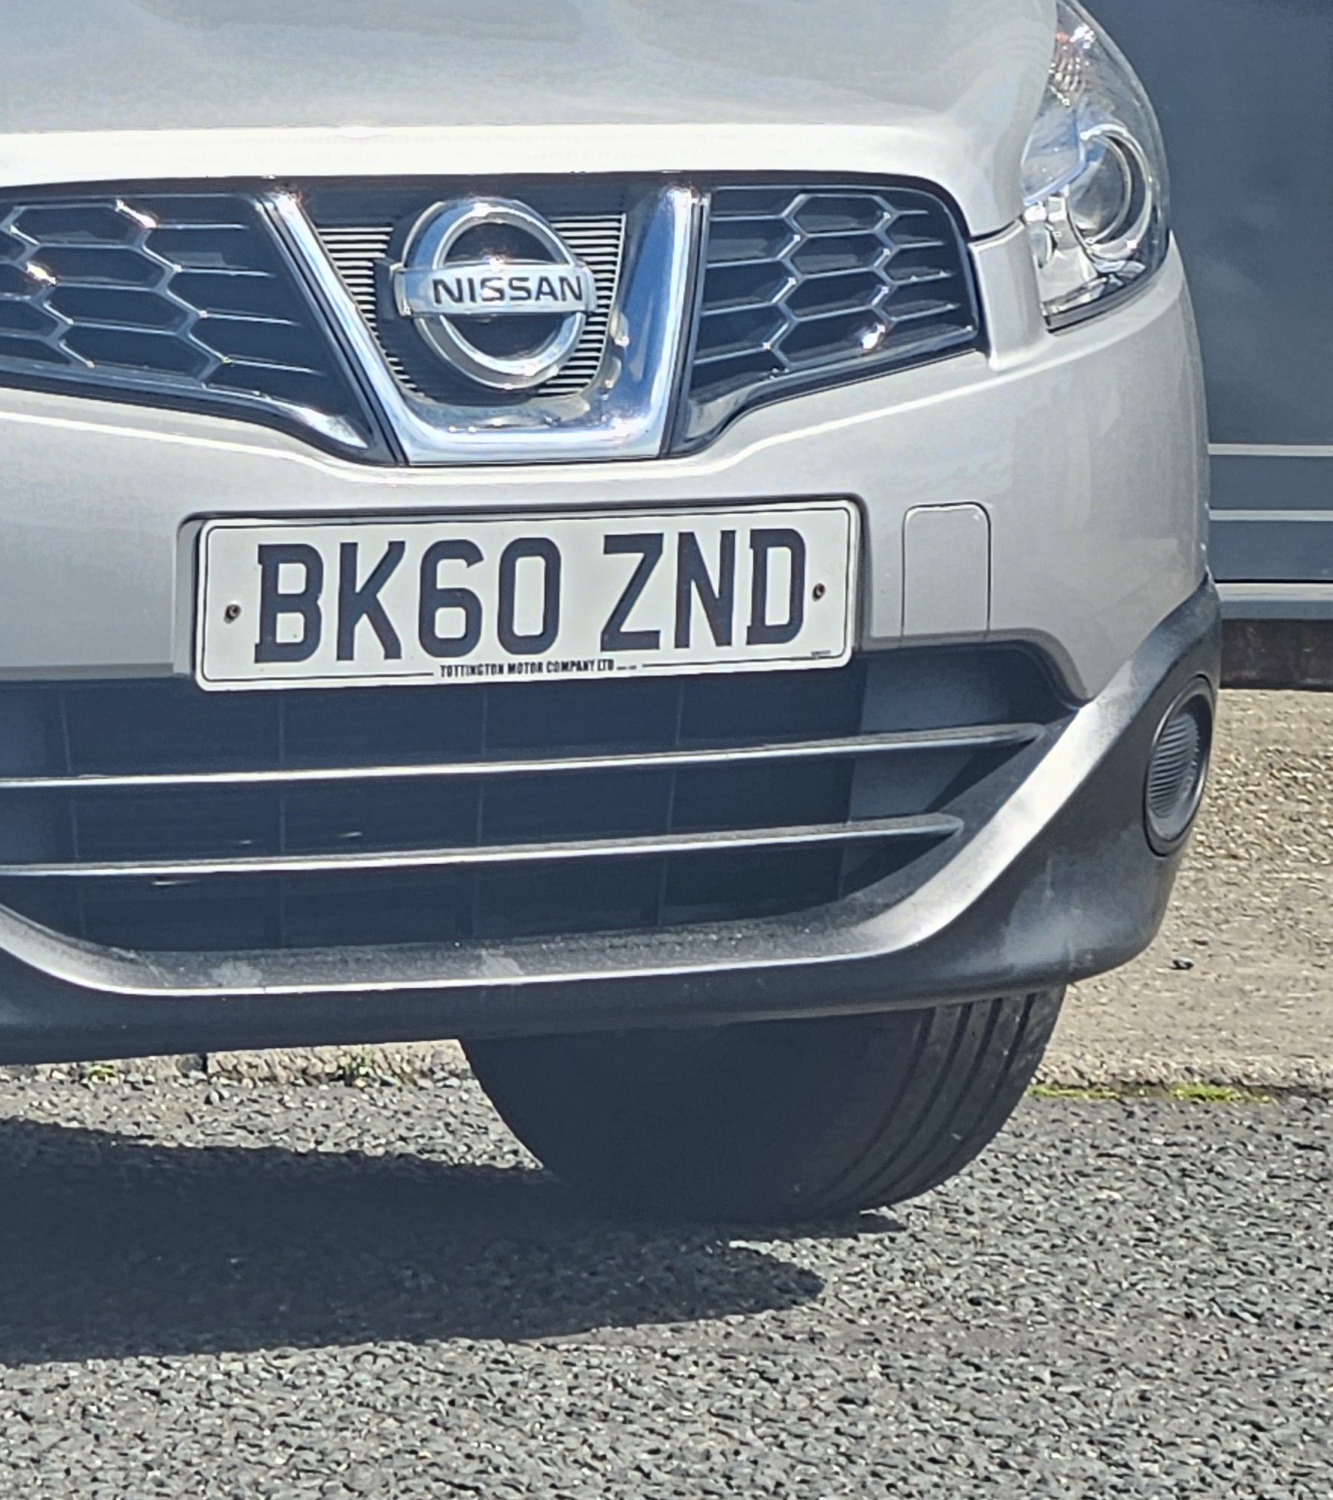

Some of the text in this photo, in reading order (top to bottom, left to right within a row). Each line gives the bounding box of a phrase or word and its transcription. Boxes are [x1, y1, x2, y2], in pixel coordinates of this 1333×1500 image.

[432, 273, 583, 305] NISSAN
[254, 527, 807, 664] BK60 ZND
[440, 664, 504, 678] TOTTINGTON
[507, 663, 544, 675] MOTOR
[546, 660, 596, 674] COMPANY
[598, 659, 614, 670] LTD
